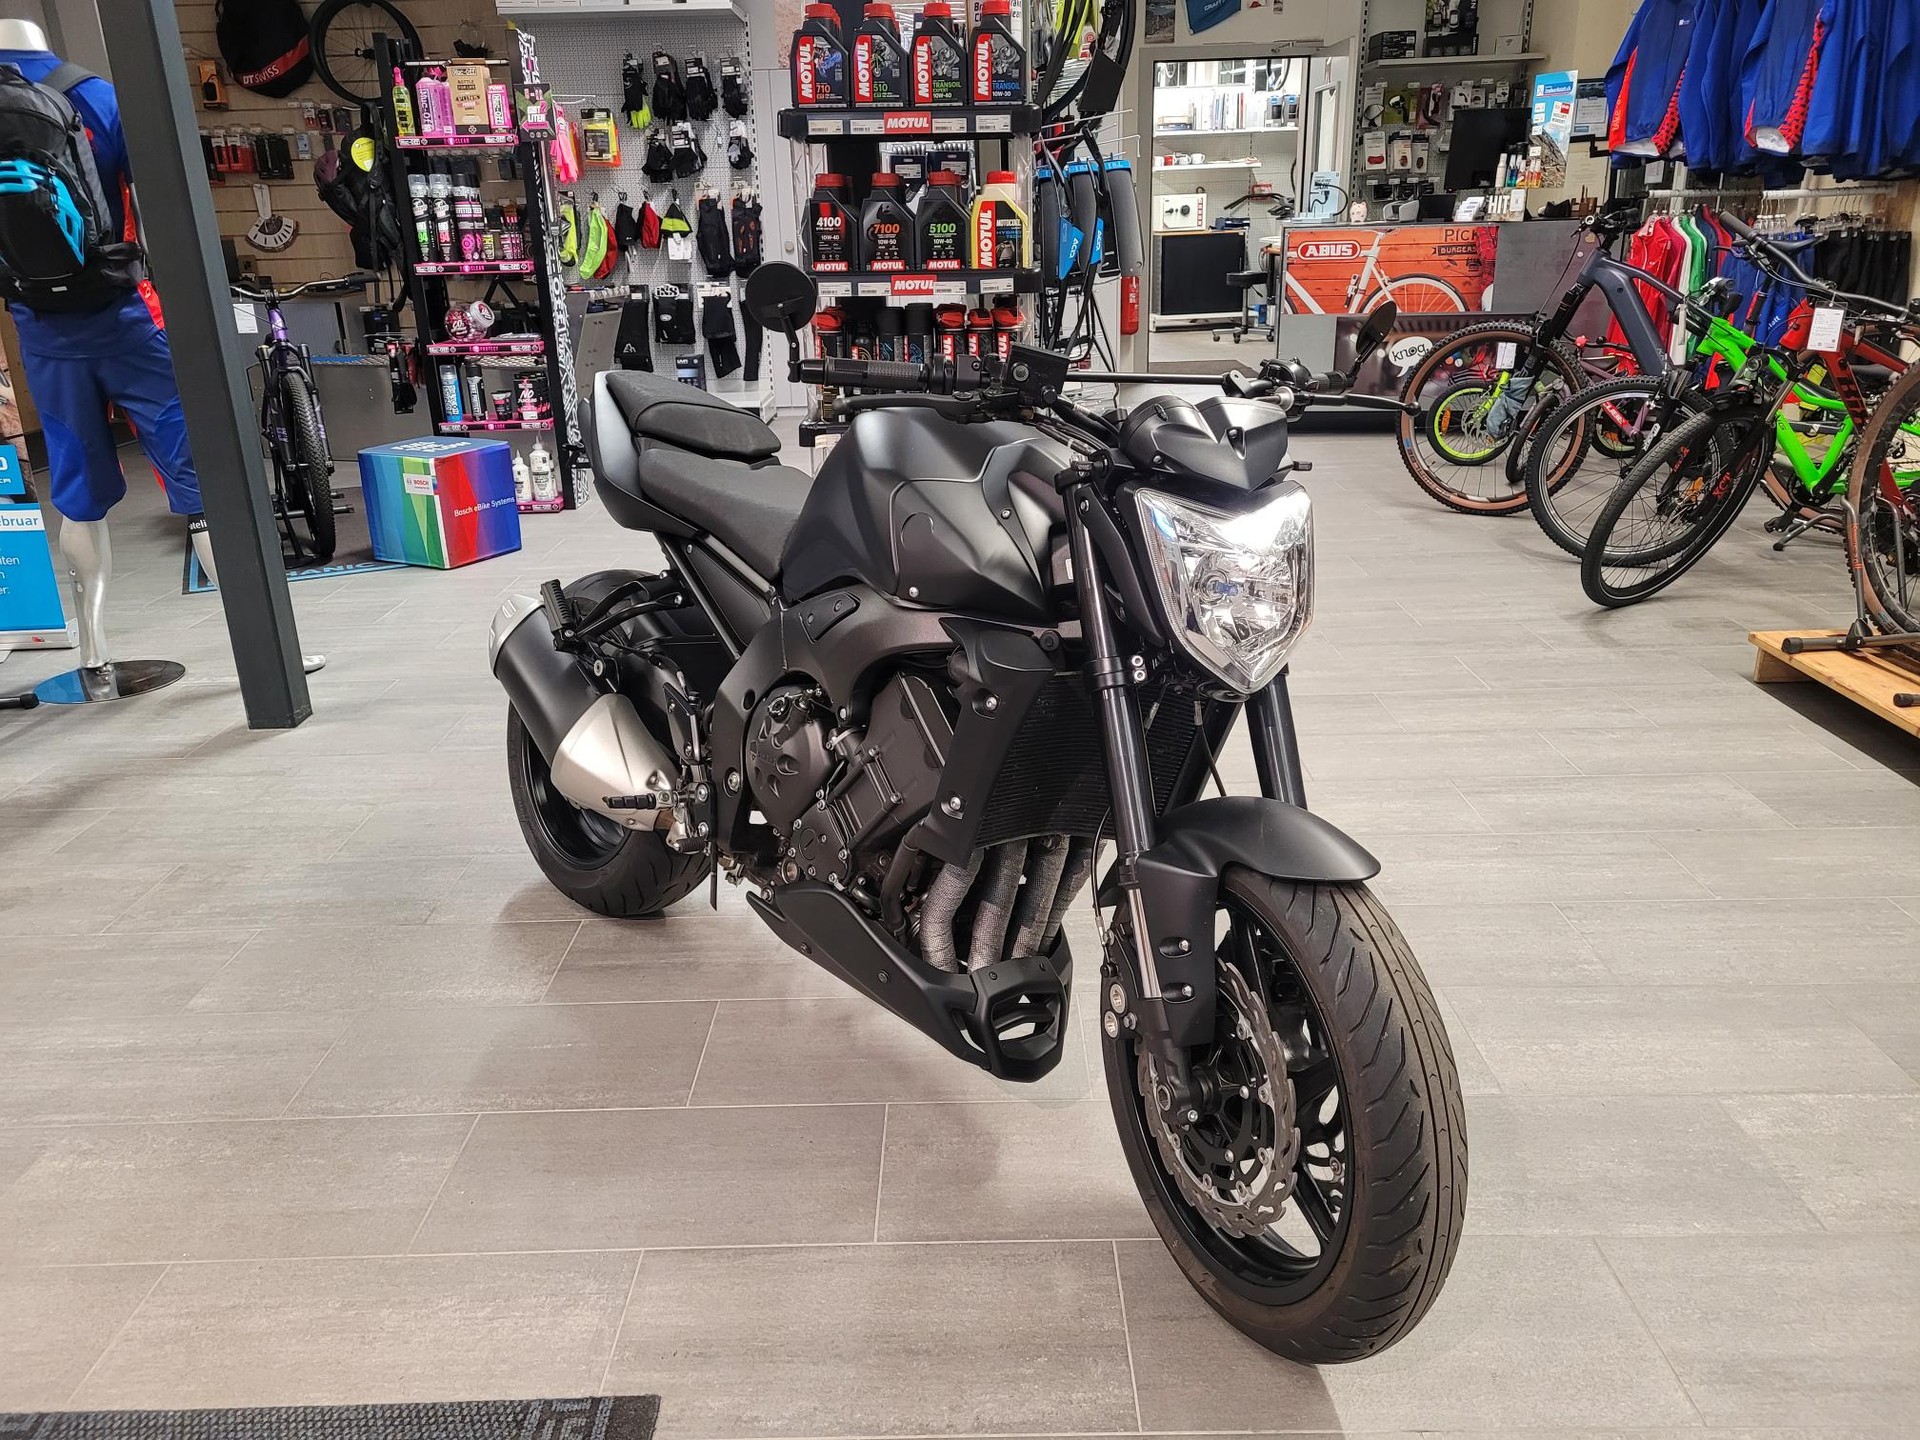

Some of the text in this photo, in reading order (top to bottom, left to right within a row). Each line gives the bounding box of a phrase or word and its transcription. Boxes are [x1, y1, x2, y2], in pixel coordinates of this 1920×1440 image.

[255, 64, 280, 83] SWISS
[800, 43, 813, 98] MOTUL
[857, 42, 870, 97] MOTUL
[917, 43, 929, 98] MOTUL
[977, 41, 989, 96] MOTUL
[816, 84, 831, 93] 710
[873, 83, 888, 92] 510
[992, 82, 1021, 90] TRANSOIL
[886, 116, 929, 129] MOTUL
[1488, 195, 1510, 213] HIT
[816, 216, 842, 227] 4100
[873, 223, 900, 234] 7100
[929, 223, 957, 233] 5100
[980, 210, 993, 267] MOTUL
[1305, 244, 1353, 257] ABUS
[815, 262, 847, 271] MOTUL
[873, 261, 904, 270] MOTUL
[928, 260, 959, 269] MOTUL
[894, 280, 934, 290] MOTUL
[519, 390, 535, 399] NO
[453, 496, 515, 517] Bosch eBike Systems
